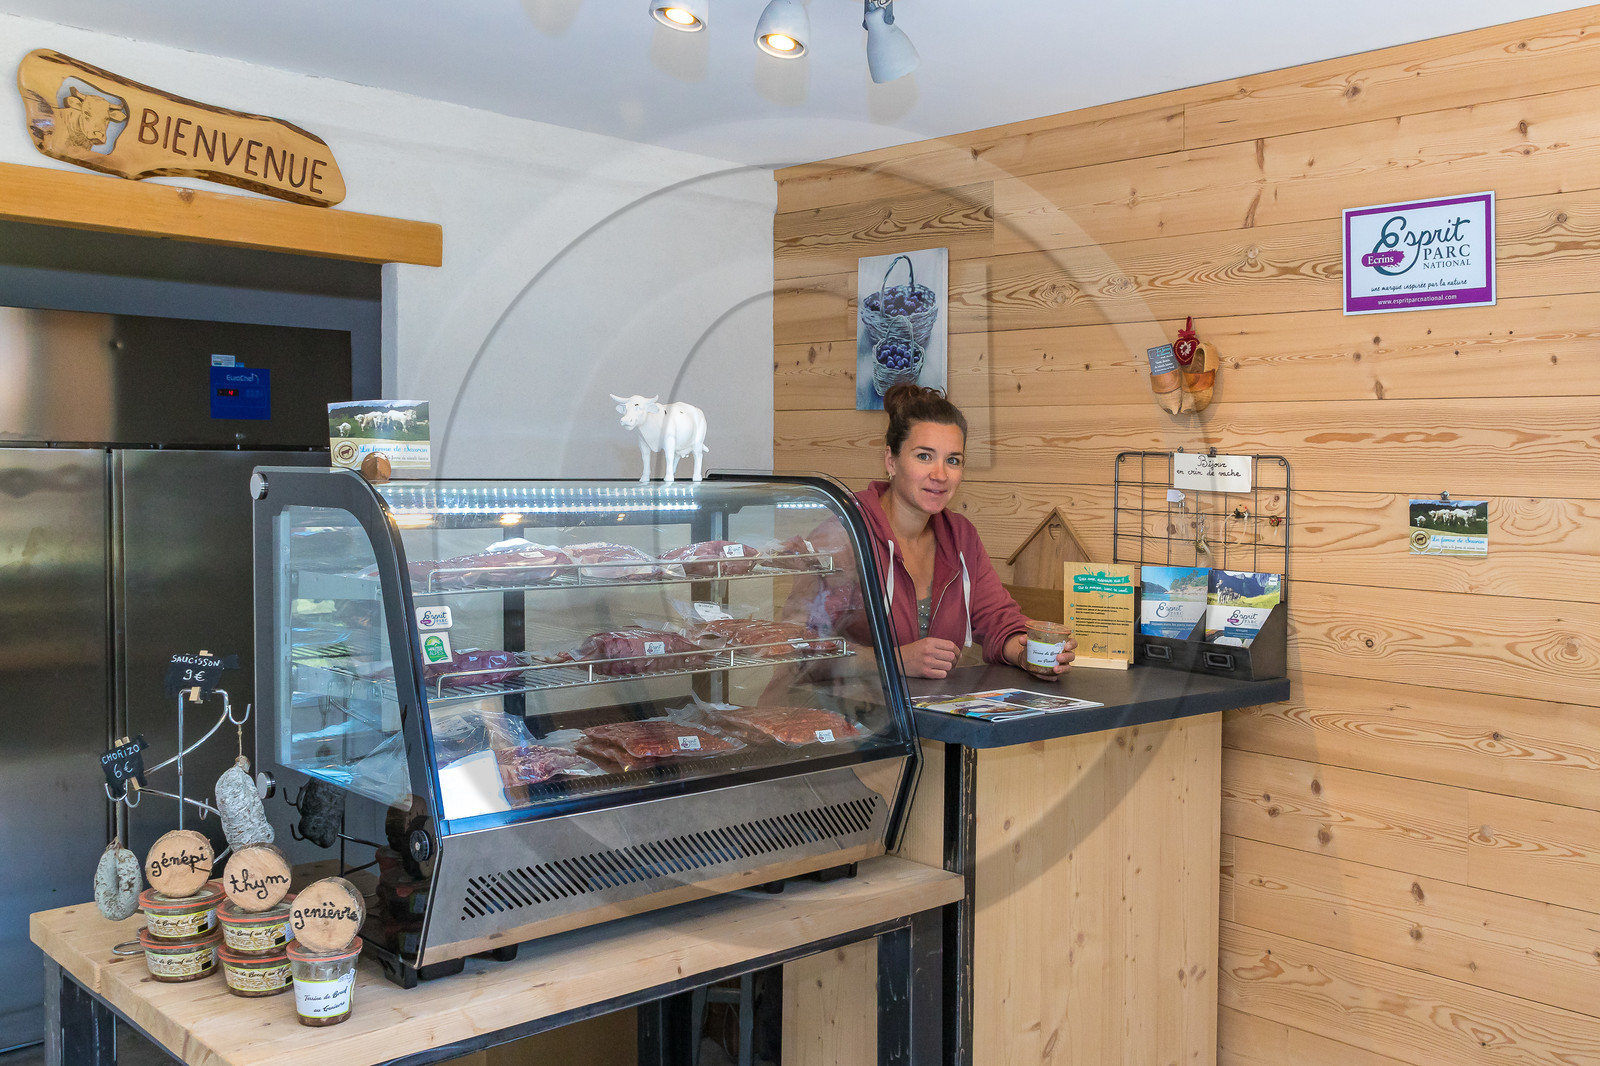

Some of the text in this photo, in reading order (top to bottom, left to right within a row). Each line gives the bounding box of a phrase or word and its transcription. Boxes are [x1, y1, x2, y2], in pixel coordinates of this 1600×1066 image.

[138, 107, 329, 195] BIENVENUE
[1372, 215, 1471, 276] Esprit
[1423, 244, 1471, 261] PARC
[1367, 254, 1395, 265] Ecrins
[1423, 259, 1472, 270] NATIONAL
[1382, 284, 1402, 292] marque
[1440, 278, 1446, 286] la
[1447, 278, 1468, 286] nature
[1377, 293, 1457, 305] www.espritparcnational.com
[1218, 468, 1242, 477] vache
[1230, 609, 1258, 626] Esprit
[101, 744, 140, 765] CHORIZO
[151, 847, 208, 877] génépi
[229, 868, 289, 899] thym
